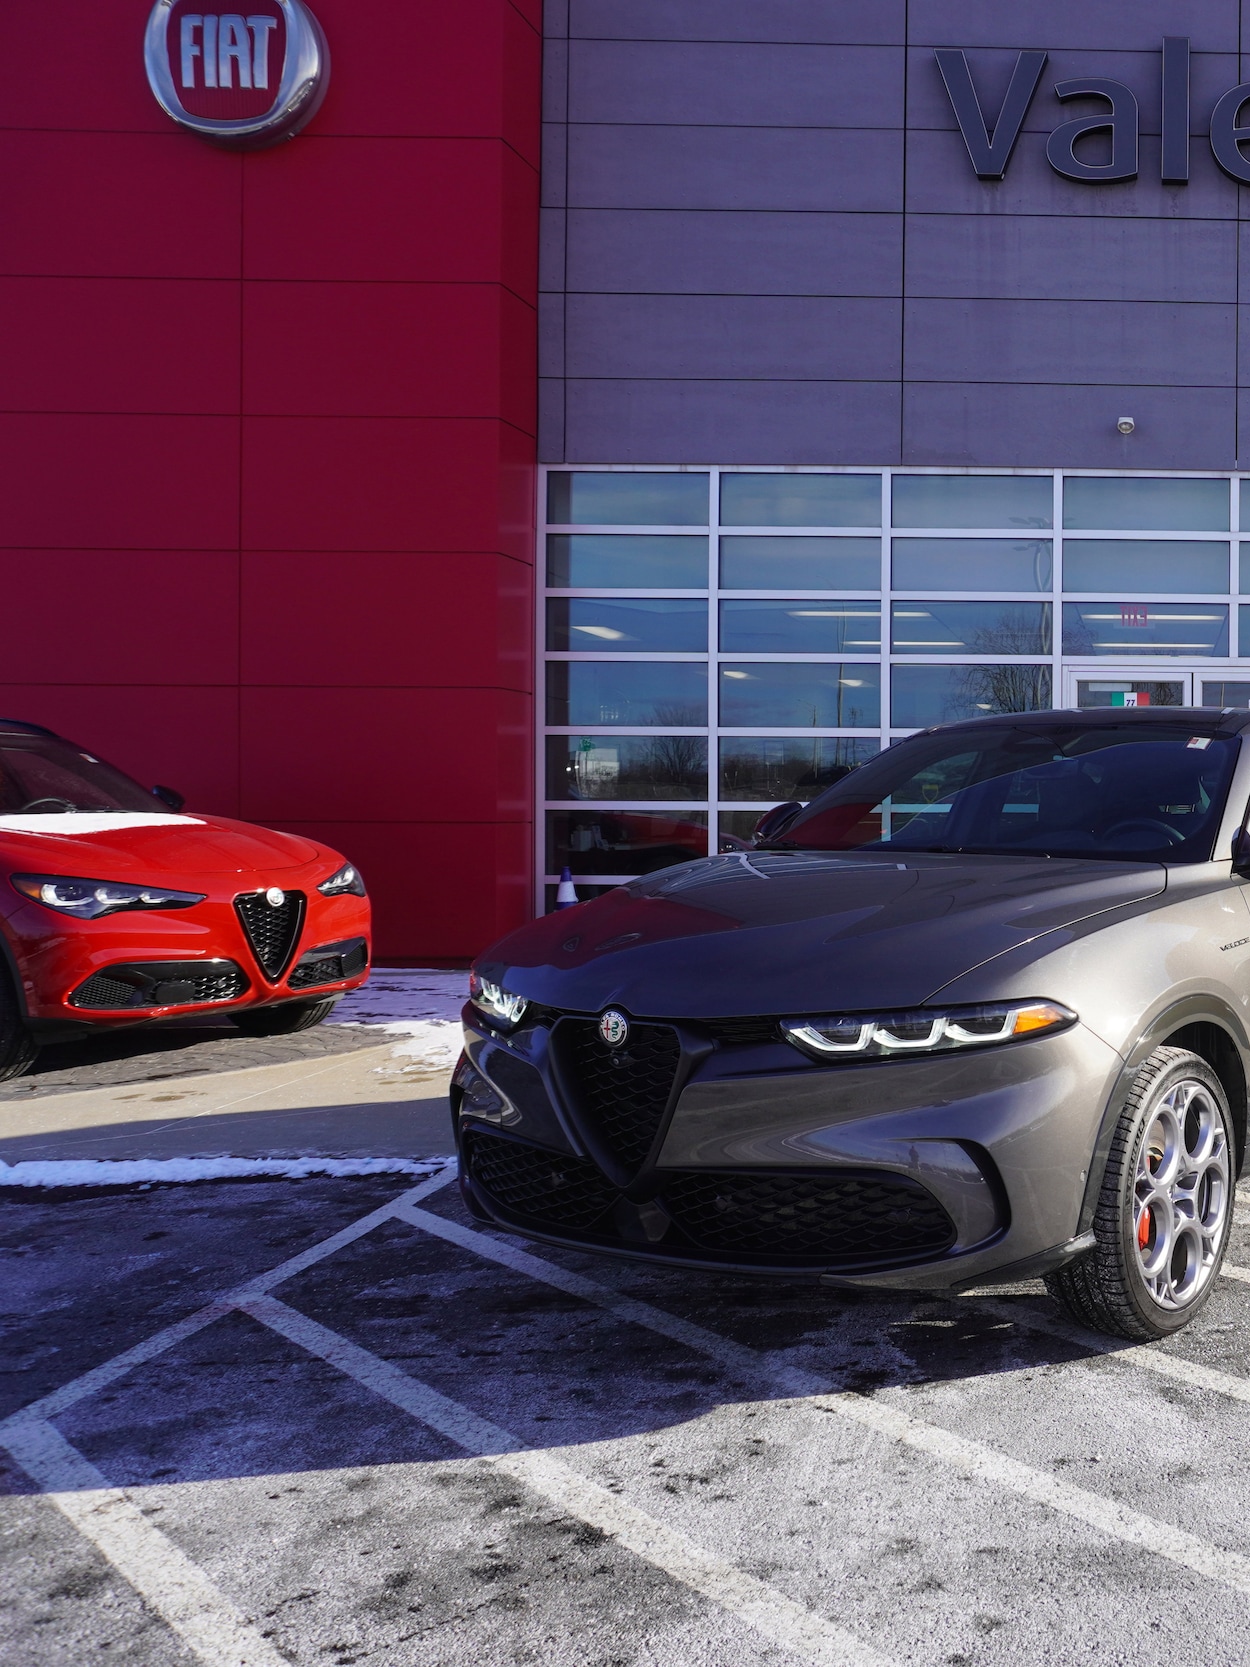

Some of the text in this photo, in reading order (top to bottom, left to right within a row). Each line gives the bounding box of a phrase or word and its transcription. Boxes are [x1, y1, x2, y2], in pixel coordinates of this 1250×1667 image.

[180, 14, 278, 90] FIAT
[1219, 936, 1250, 952] VELOCE
[1126, 1117, 1146, 1188] MICHELIN
